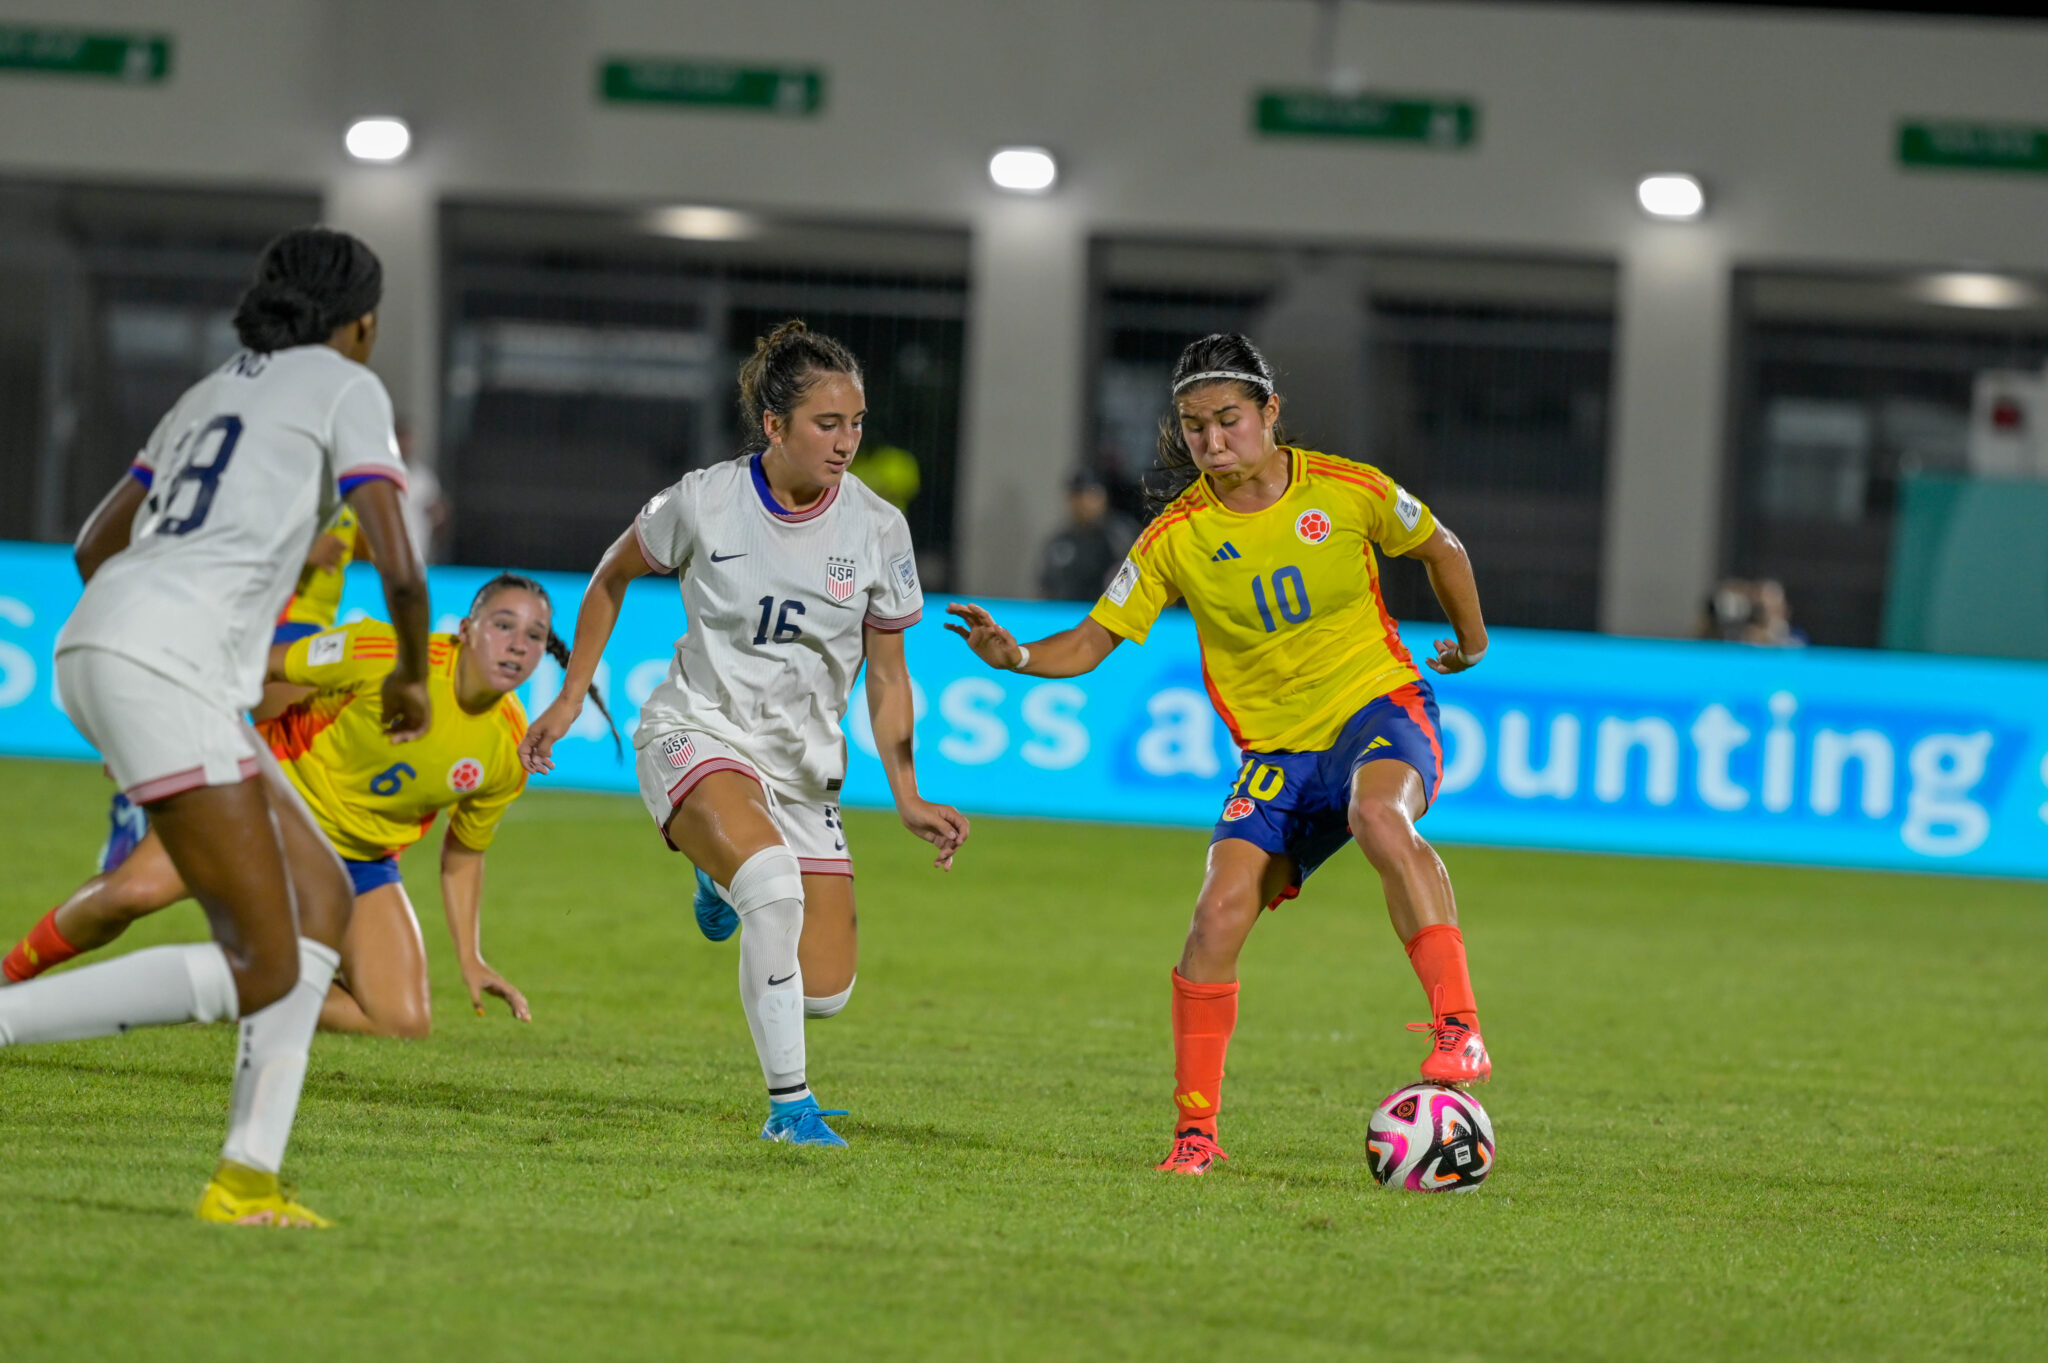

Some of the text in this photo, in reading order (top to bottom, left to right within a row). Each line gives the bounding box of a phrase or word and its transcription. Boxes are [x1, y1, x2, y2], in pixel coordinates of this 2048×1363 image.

[829, 565, 853, 582] USA
[753, 595, 806, 645] 16
[1251, 565, 1312, 633] 10
[665, 736, 688, 755] USA
[370, 761, 417, 796] 6
[1137, 687, 1993, 858] aounting
[1230, 758, 1285, 801] 10
